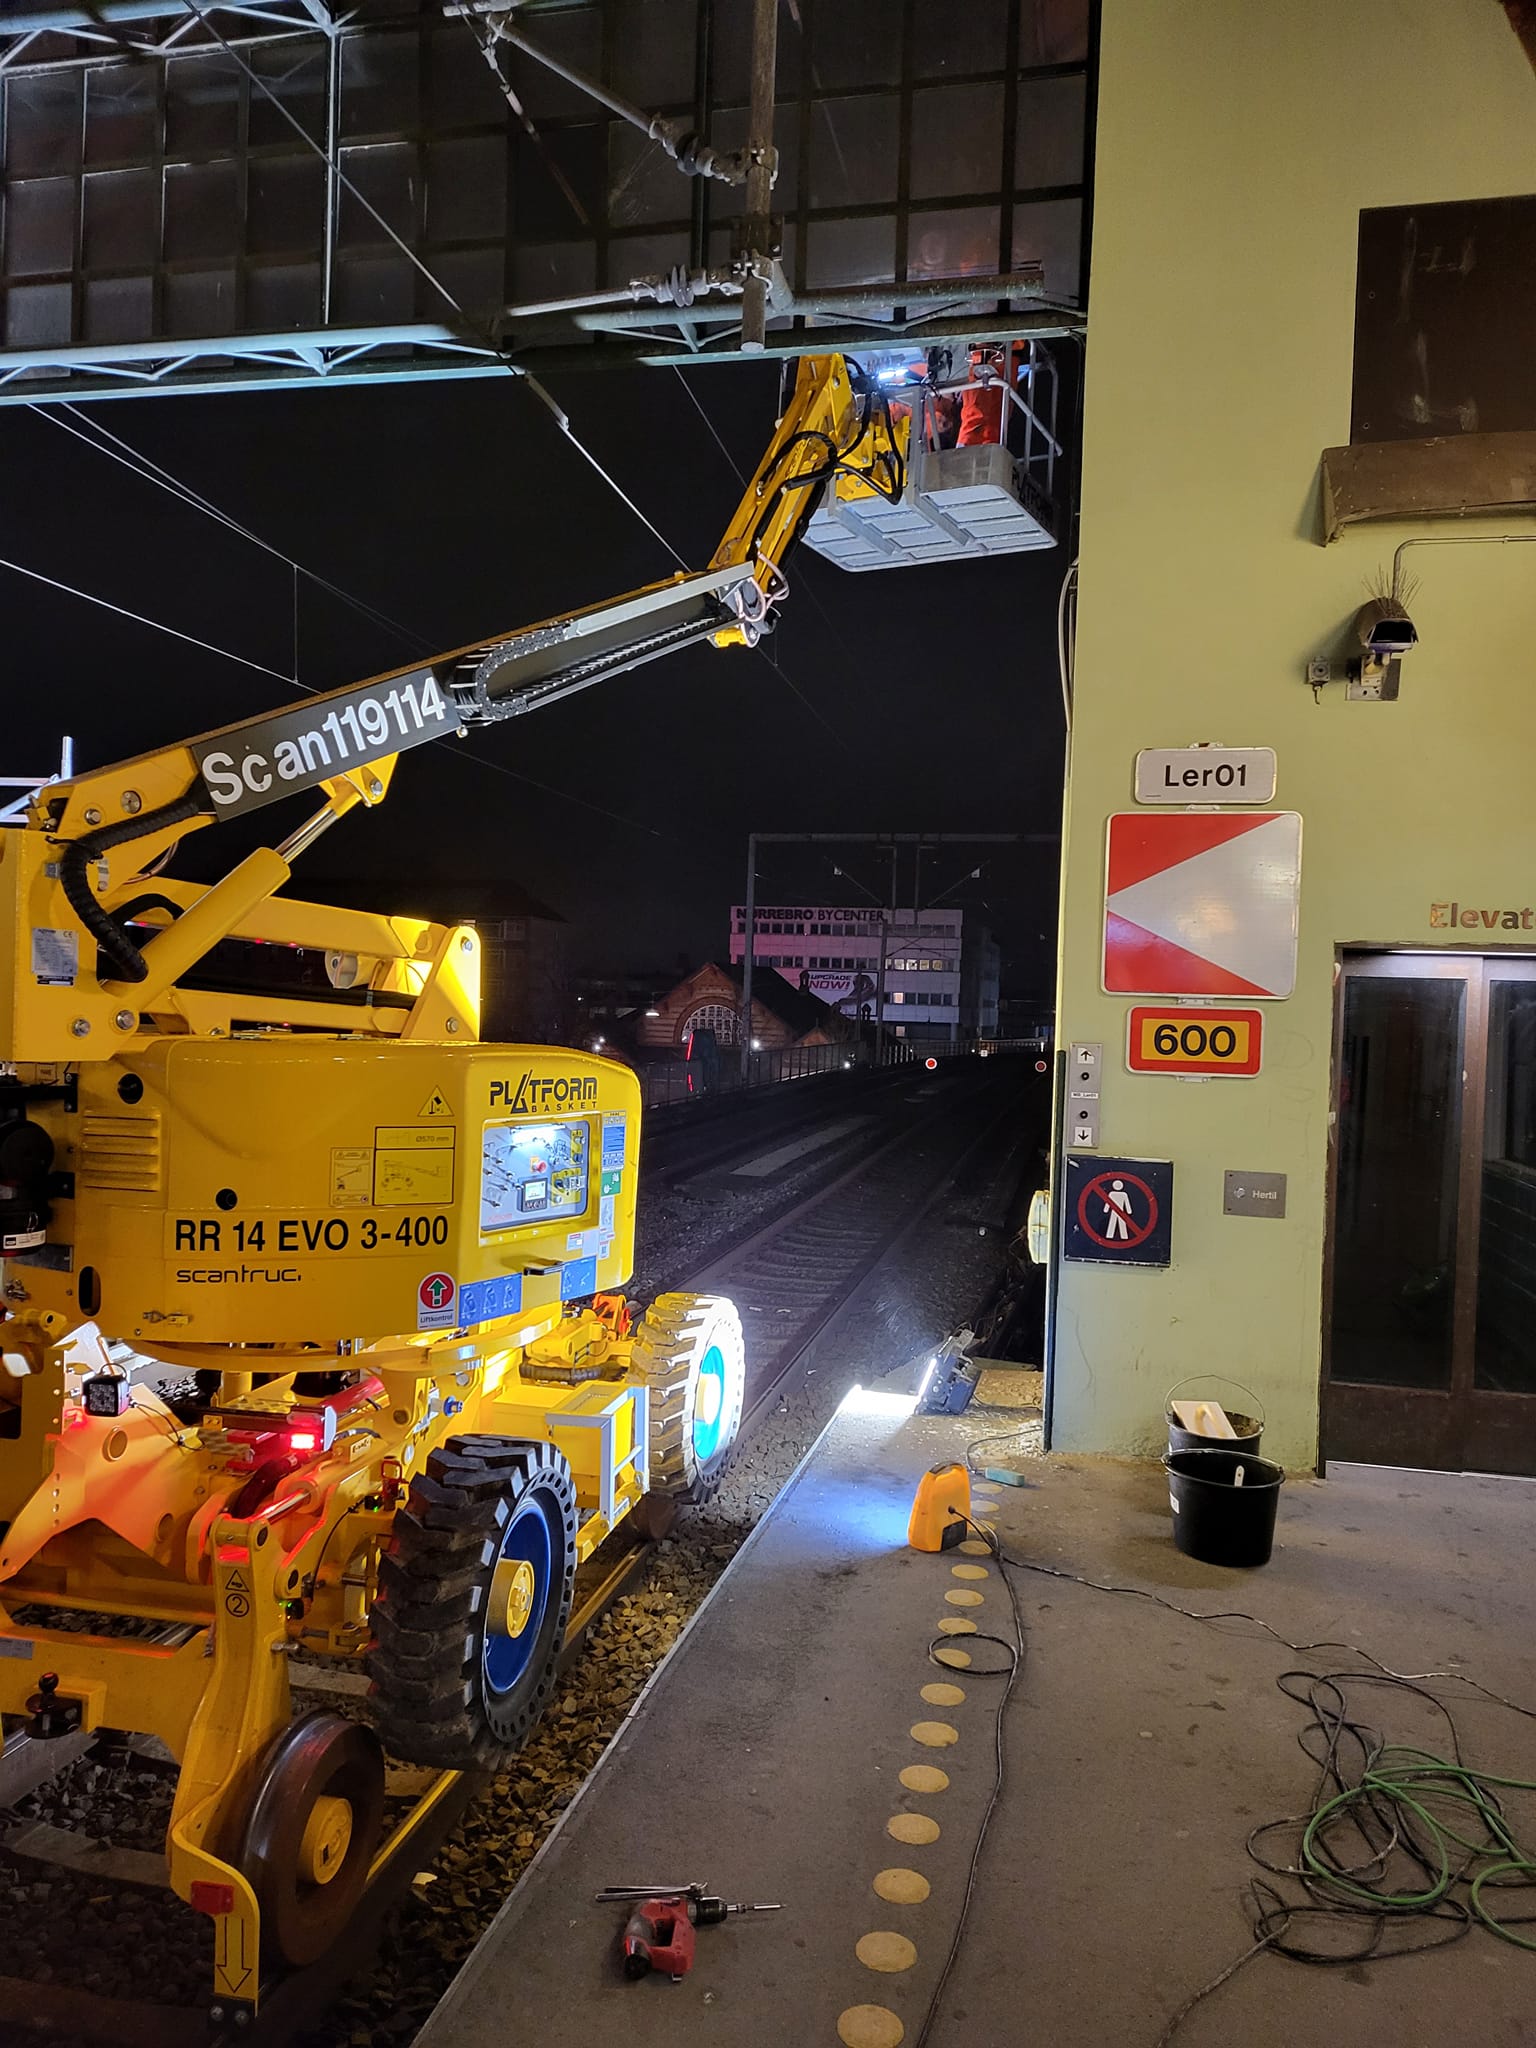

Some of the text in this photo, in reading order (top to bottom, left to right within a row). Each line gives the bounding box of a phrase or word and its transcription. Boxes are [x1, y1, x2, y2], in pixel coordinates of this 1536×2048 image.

[817, 909, 885, 922] BYCENTER
[1429, 902, 1536, 930] Elevat
[809, 980, 851, 990] NOW!
[1154, 1024, 1236, 1058] 600
[490, 1069, 598, 1114] PLATFORM
[531, 1101, 598, 1113] BASKET
[1252, 1189, 1277, 1200] Hertil
[175, 1215, 448, 1251] RR 14 EVO 3-400
[232, 1596, 244, 1614] 2
